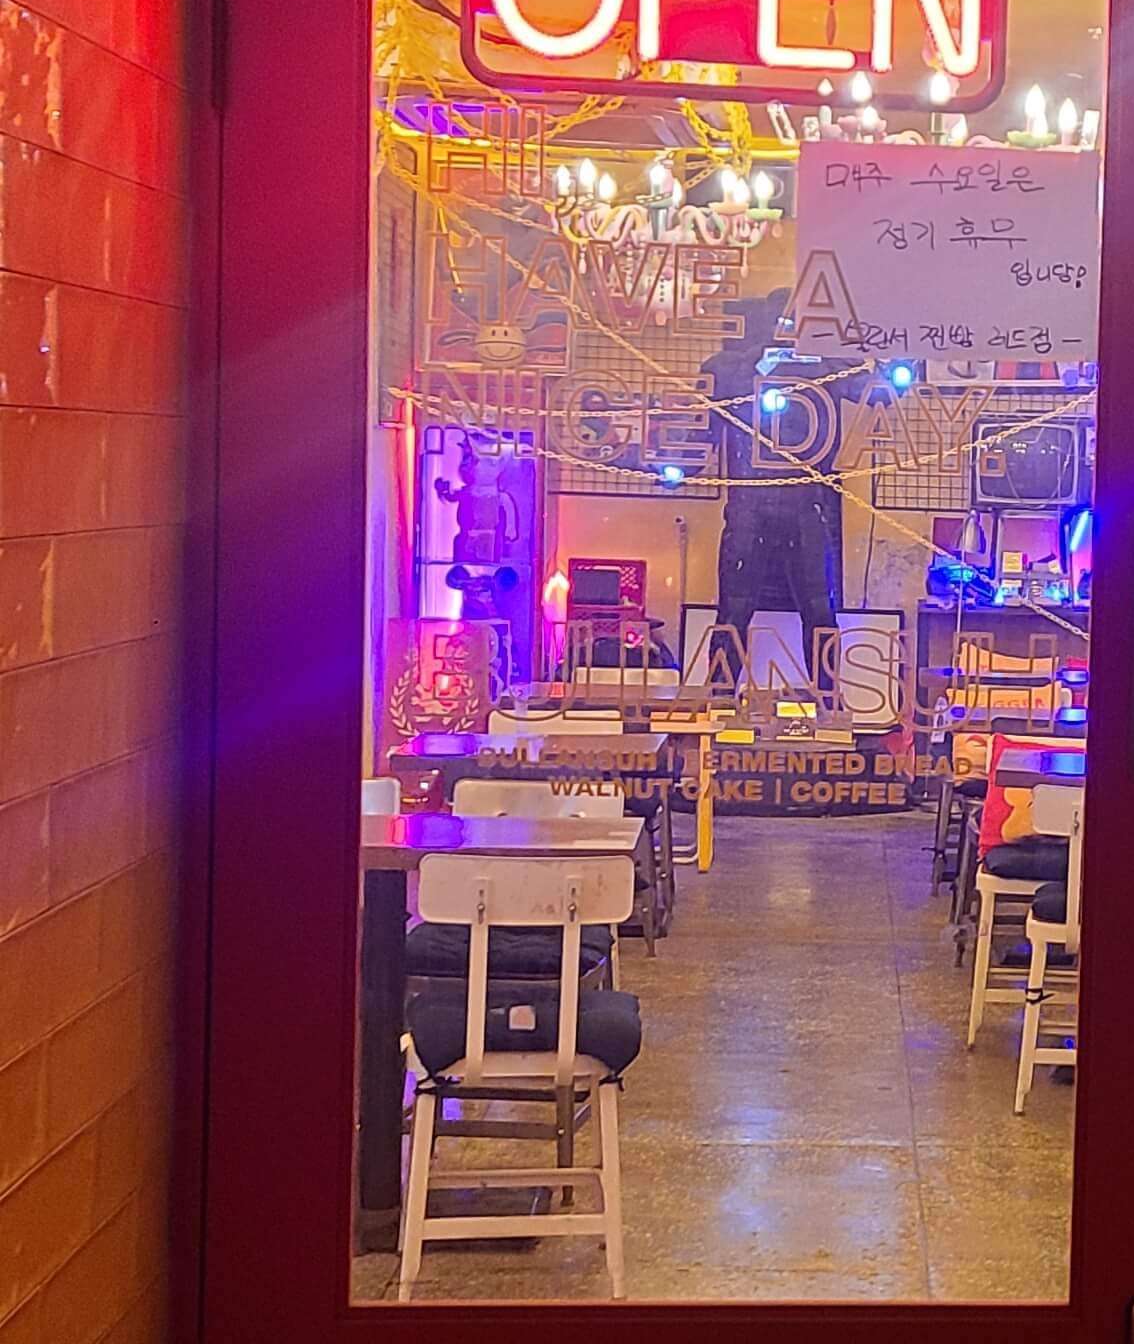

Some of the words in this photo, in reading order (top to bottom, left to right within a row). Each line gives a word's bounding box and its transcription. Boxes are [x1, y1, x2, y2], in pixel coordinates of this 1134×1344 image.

[825, 162, 892, 193] 매주
[910, 159, 1045, 194] 수요일은
[873, 217, 935, 250] 정기
[949, 216, 1028, 249] 휴무
[427, 233, 748, 339] HAVE
[773, 249, 865, 342] A
[421, 367, 716, 465] NICE
[416, 620, 1058, 735] BULLANSUH
[683, 749, 864, 775] FERMENTED
[874, 753, 973, 777] BREAD
[551, 777, 671, 800] WALNUT
[679, 779, 763, 802] CAKE
[790, 781, 906, 805] COFFEE
